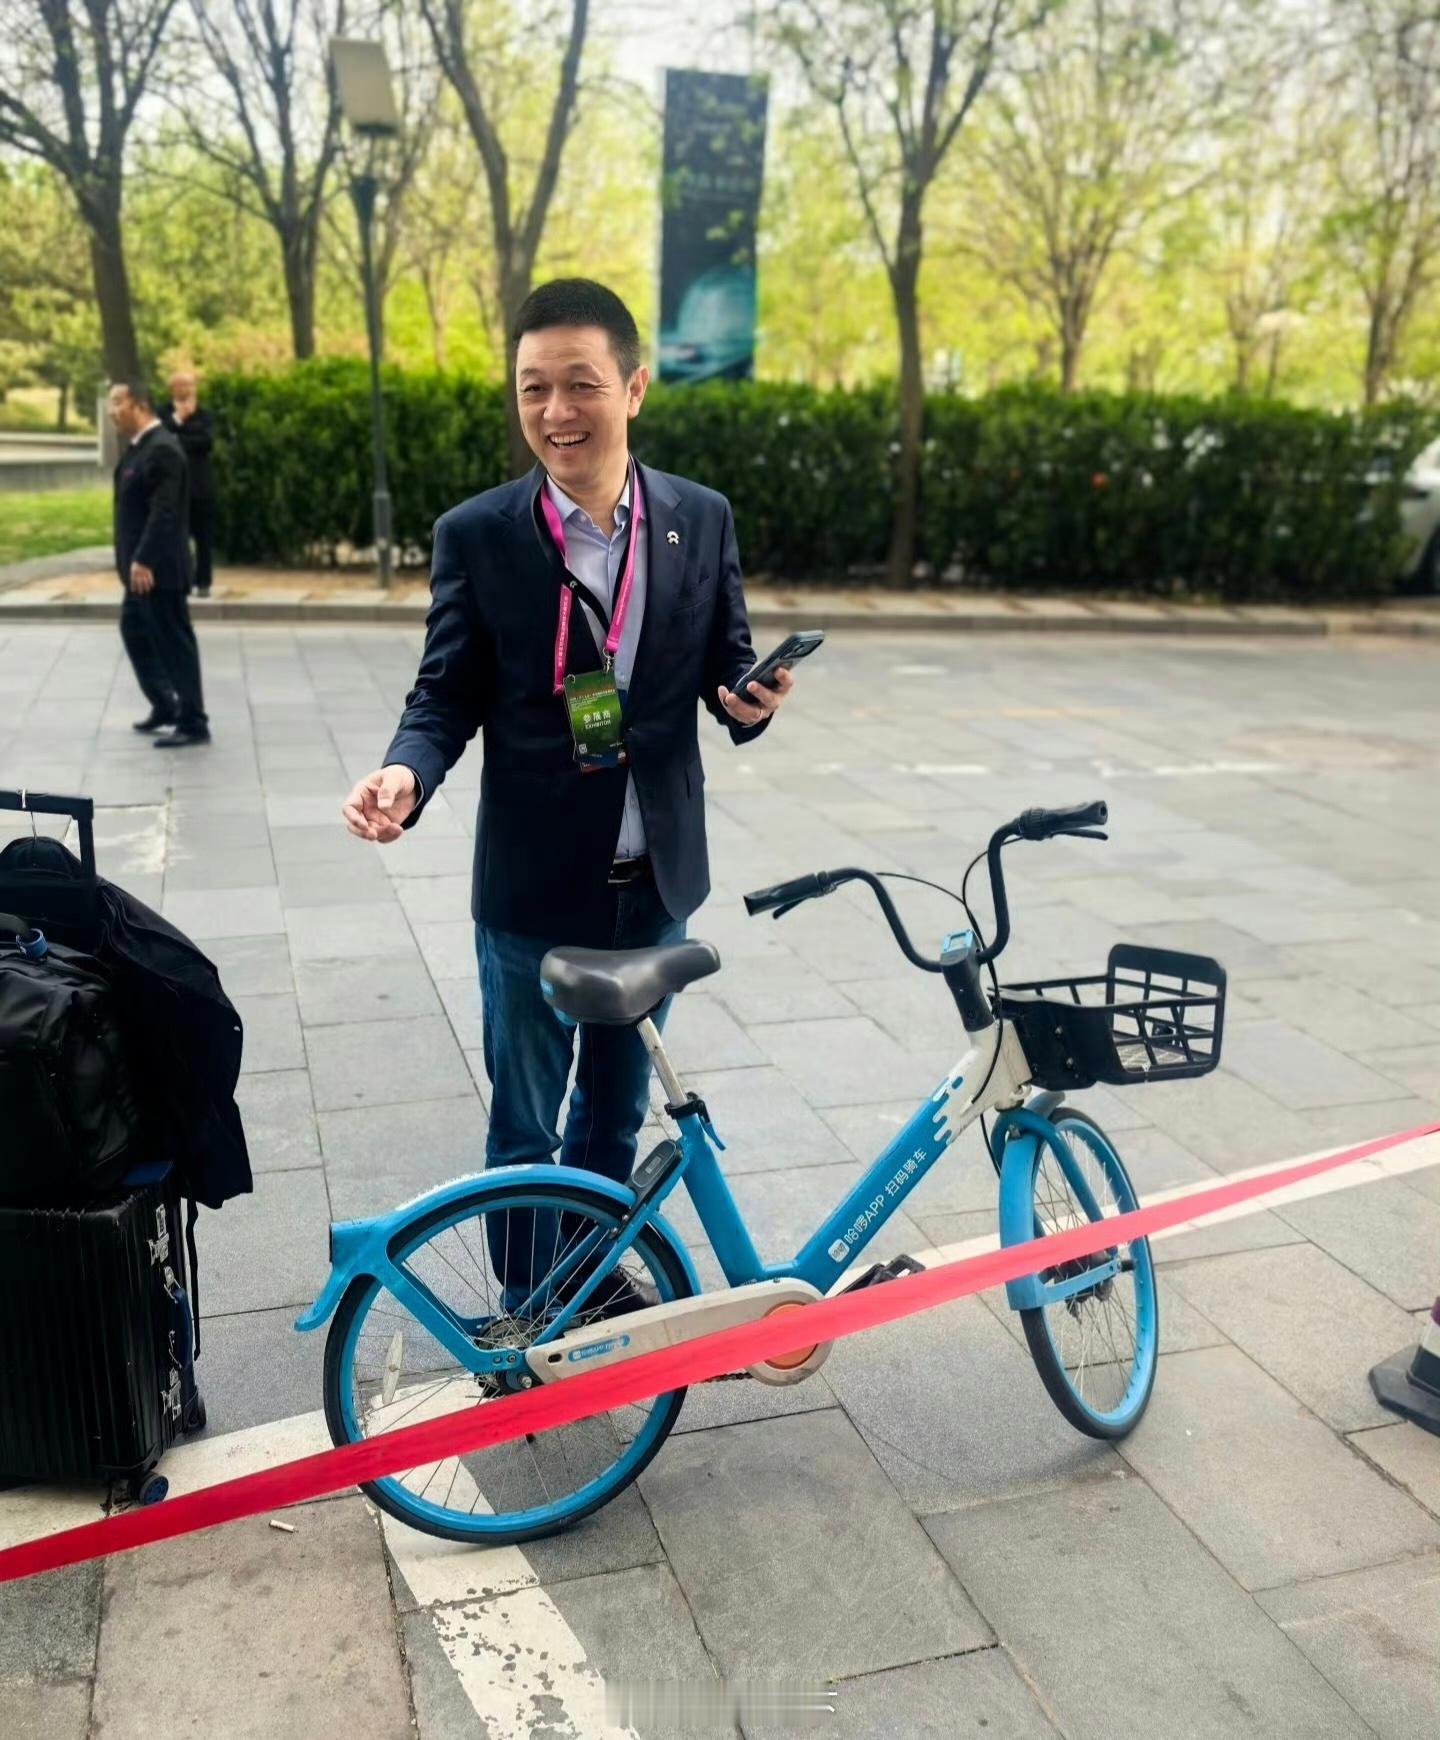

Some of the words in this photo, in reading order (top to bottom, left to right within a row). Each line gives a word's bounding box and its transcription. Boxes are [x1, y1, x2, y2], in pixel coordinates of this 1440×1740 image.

[585, 719, 611, 730] EXHIBITOR
[885, 1148, 927, 1197] 扫码骑车
